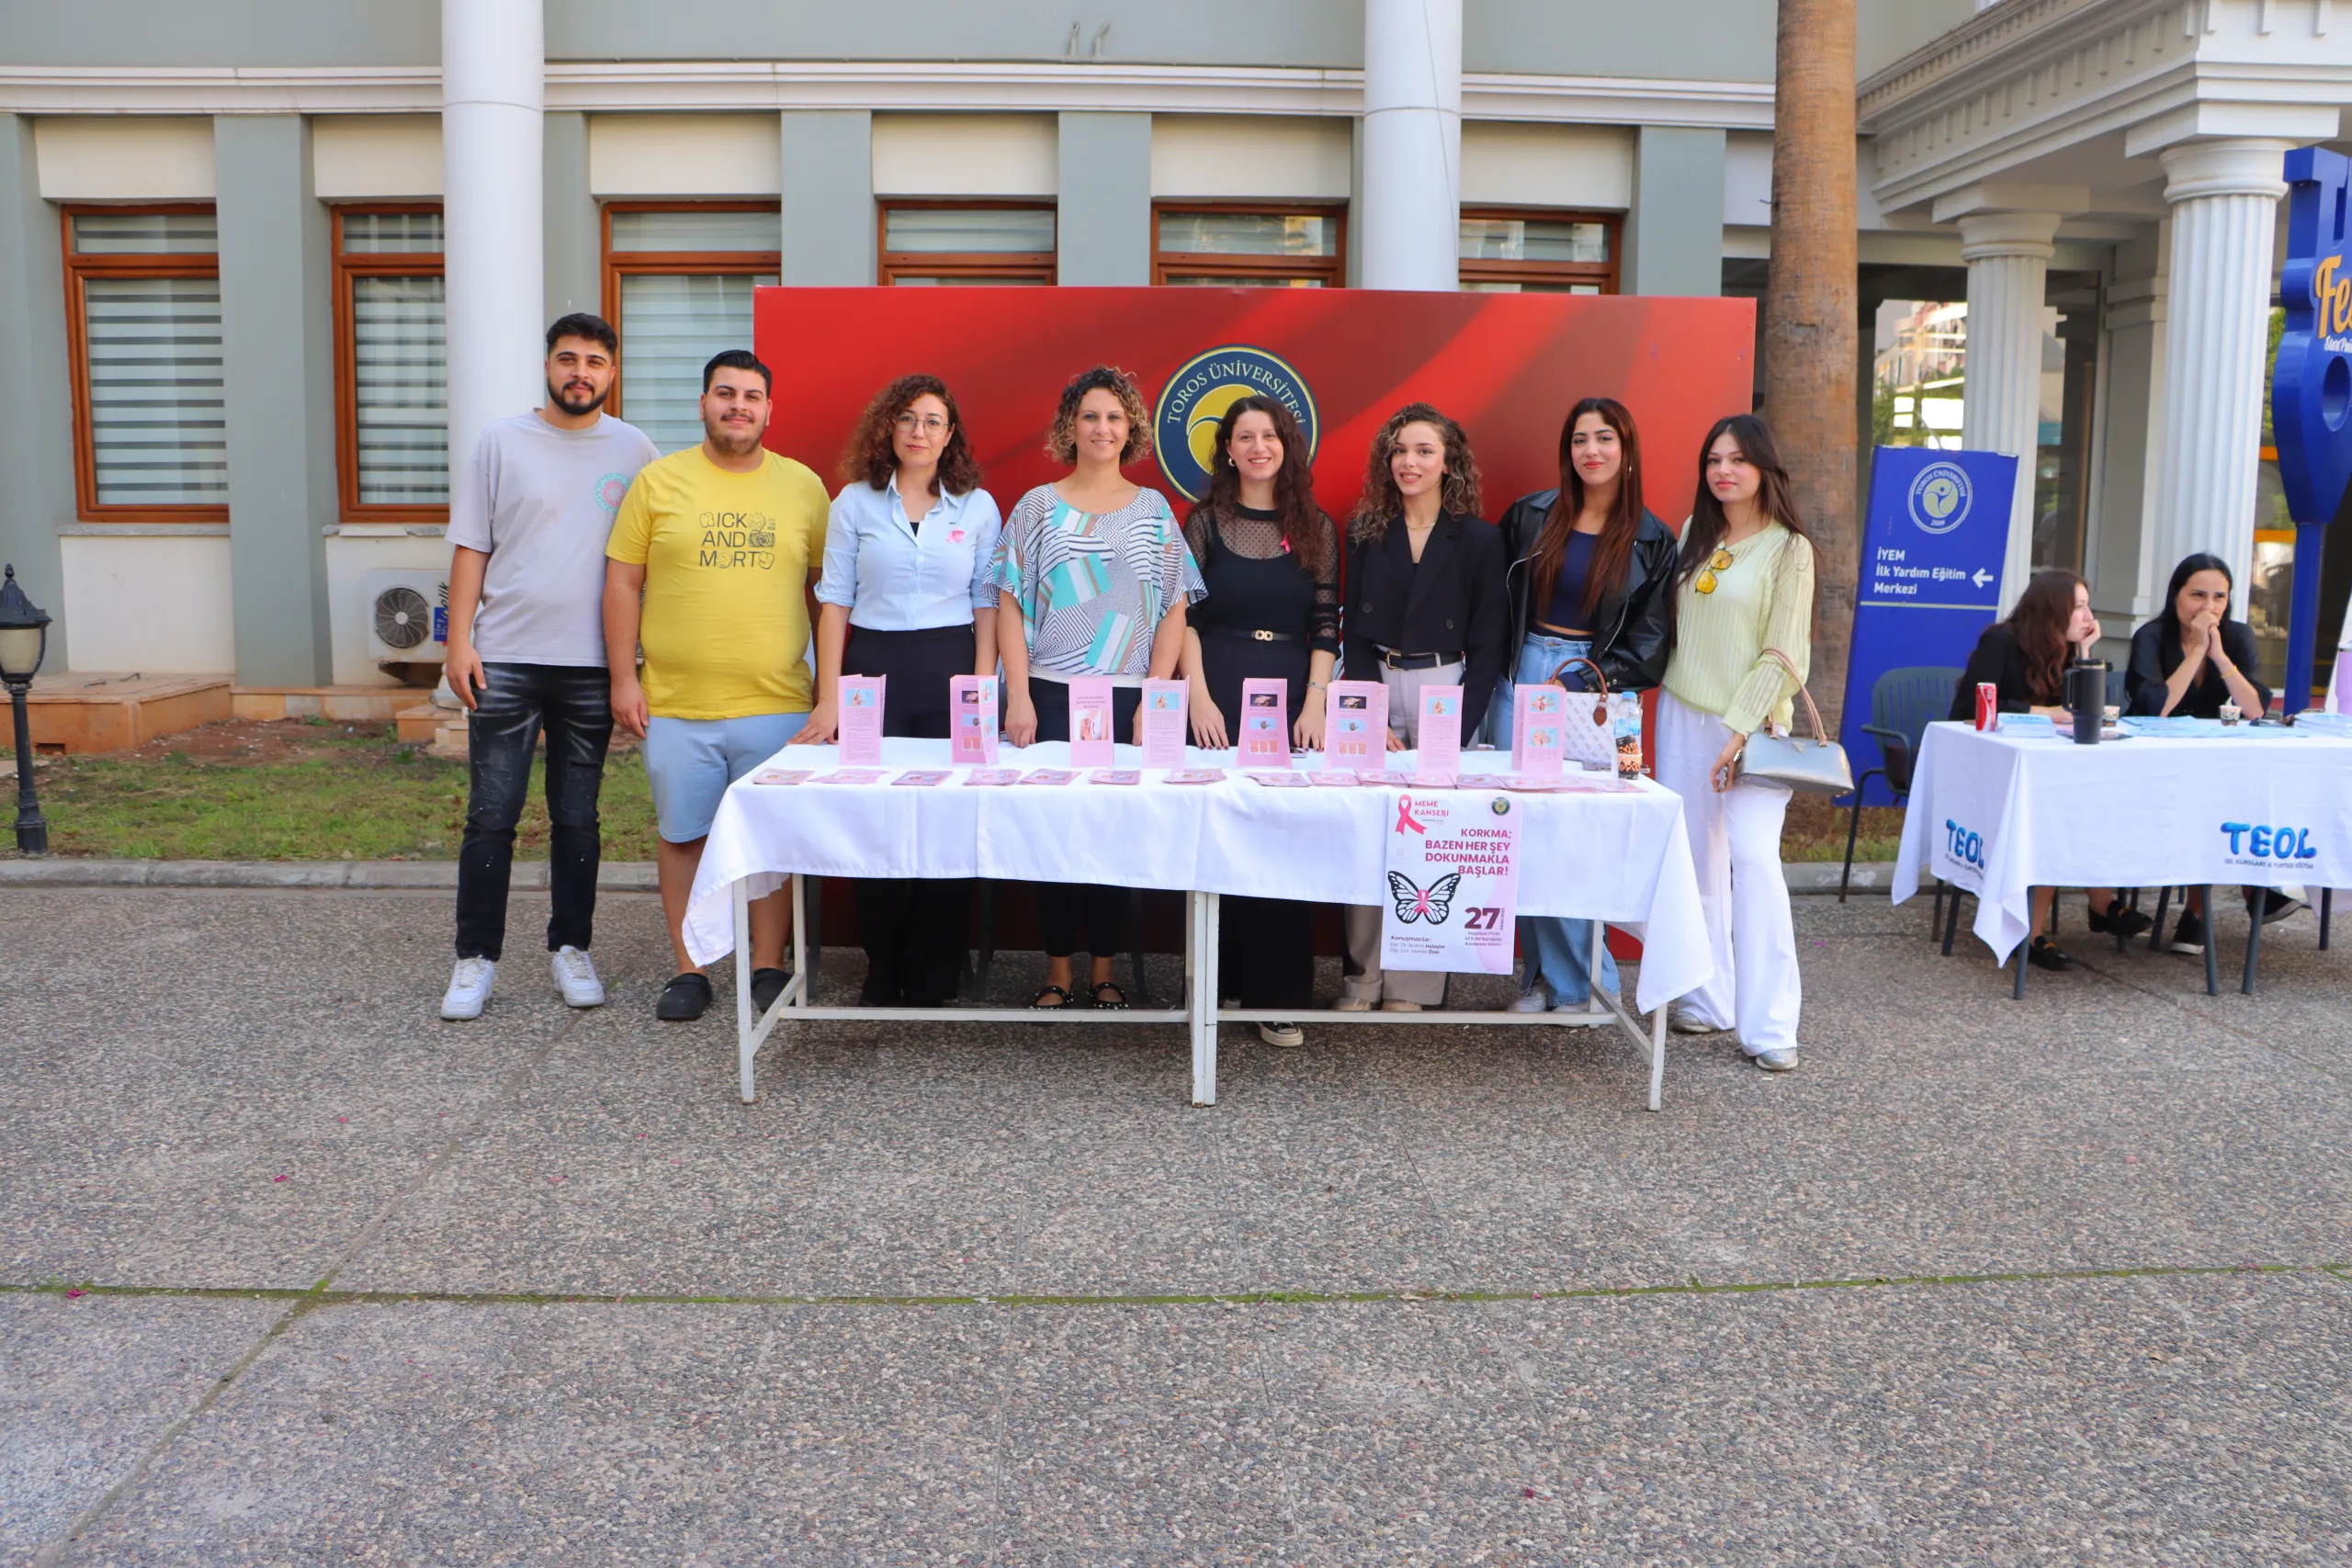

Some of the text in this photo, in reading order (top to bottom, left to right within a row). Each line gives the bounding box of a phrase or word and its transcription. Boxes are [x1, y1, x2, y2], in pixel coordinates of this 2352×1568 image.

[2315, 254, 2352, 339] Fe
[1167, 372, 1208, 424] TOROS
[1915, 473, 1934, 495] TOROS
[701, 530, 746, 547] AND
[1877, 547, 1905, 561] İYEM
[1875, 563, 1967, 581] İlk Yardım Eğitim
[1873, 581, 1918, 595] Merkezi
[1415, 800, 1439, 808] MEME
[1461, 829, 1512, 840] KORKMA;
[2220, 821, 2318, 859] TEOL
[1425, 840, 1511, 854] BAZEN HER ŞEY
[1946, 819, 1984, 870] TEOL
[1425, 852, 1510, 864] DOKUNMAKLA
[1458, 864, 1509, 878] BAŞLAR!
[1464, 907, 1500, 930] 27
